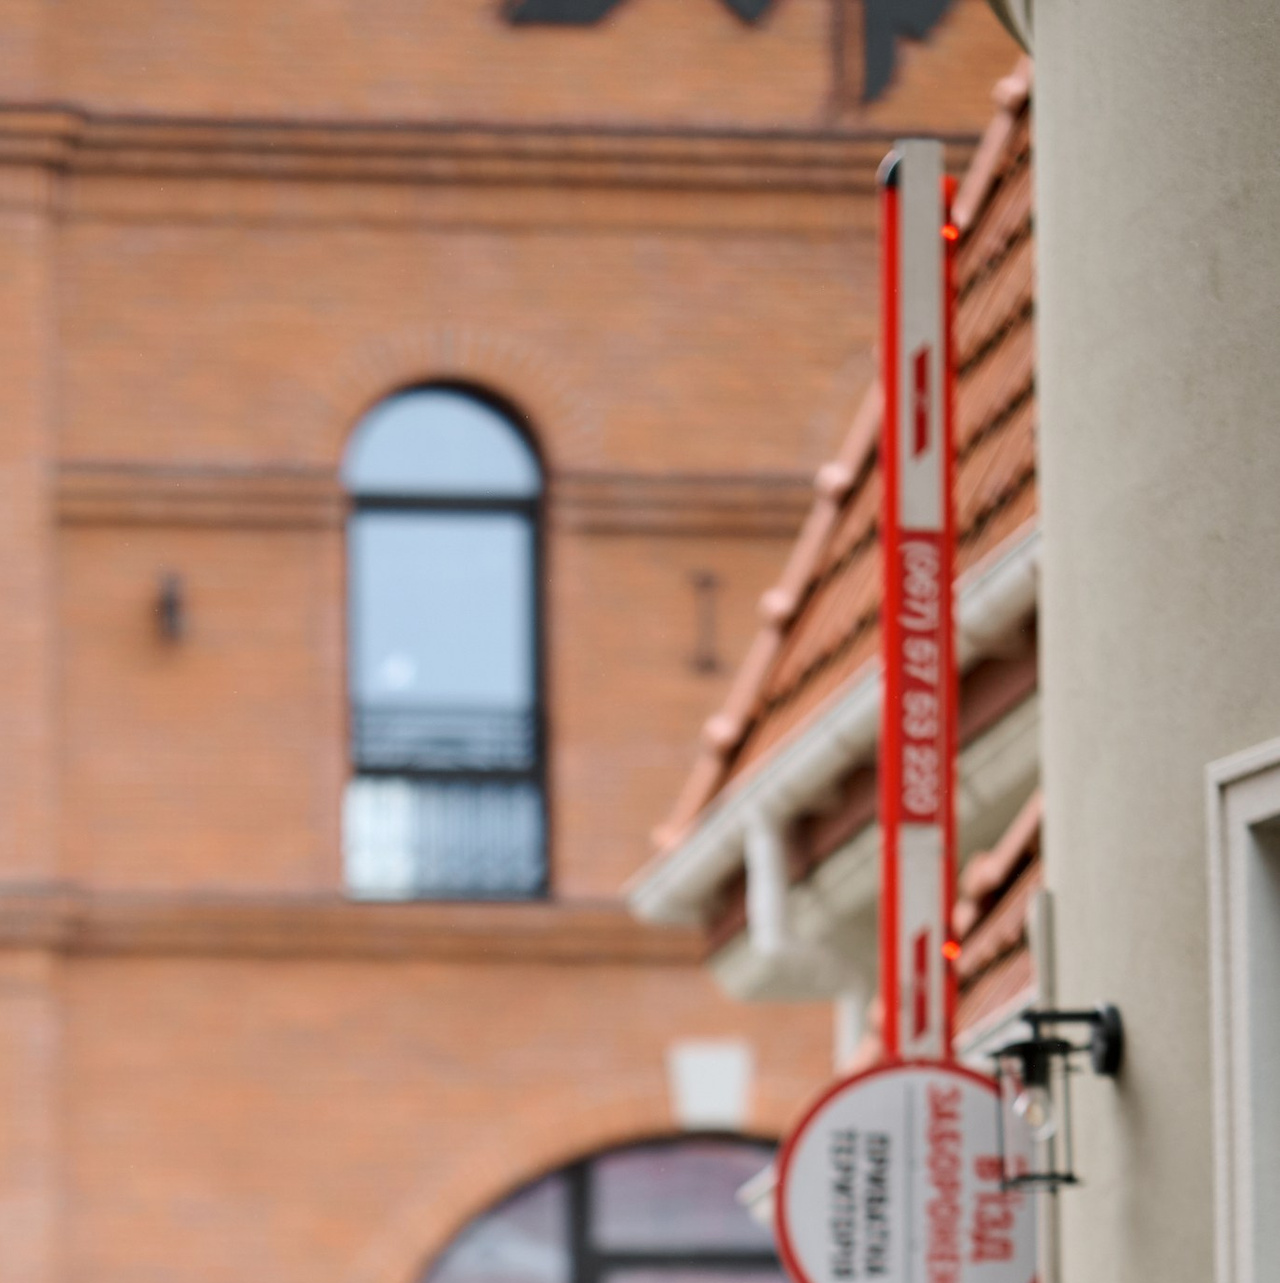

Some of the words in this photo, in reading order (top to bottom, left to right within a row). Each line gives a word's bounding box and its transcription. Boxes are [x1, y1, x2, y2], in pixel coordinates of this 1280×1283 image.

[902, 744, 938, 815] 220
[830, 1128, 858, 1282] ТЕРИТОРІЯ
[865, 1131, 891, 1279] ПРИВАТНА
